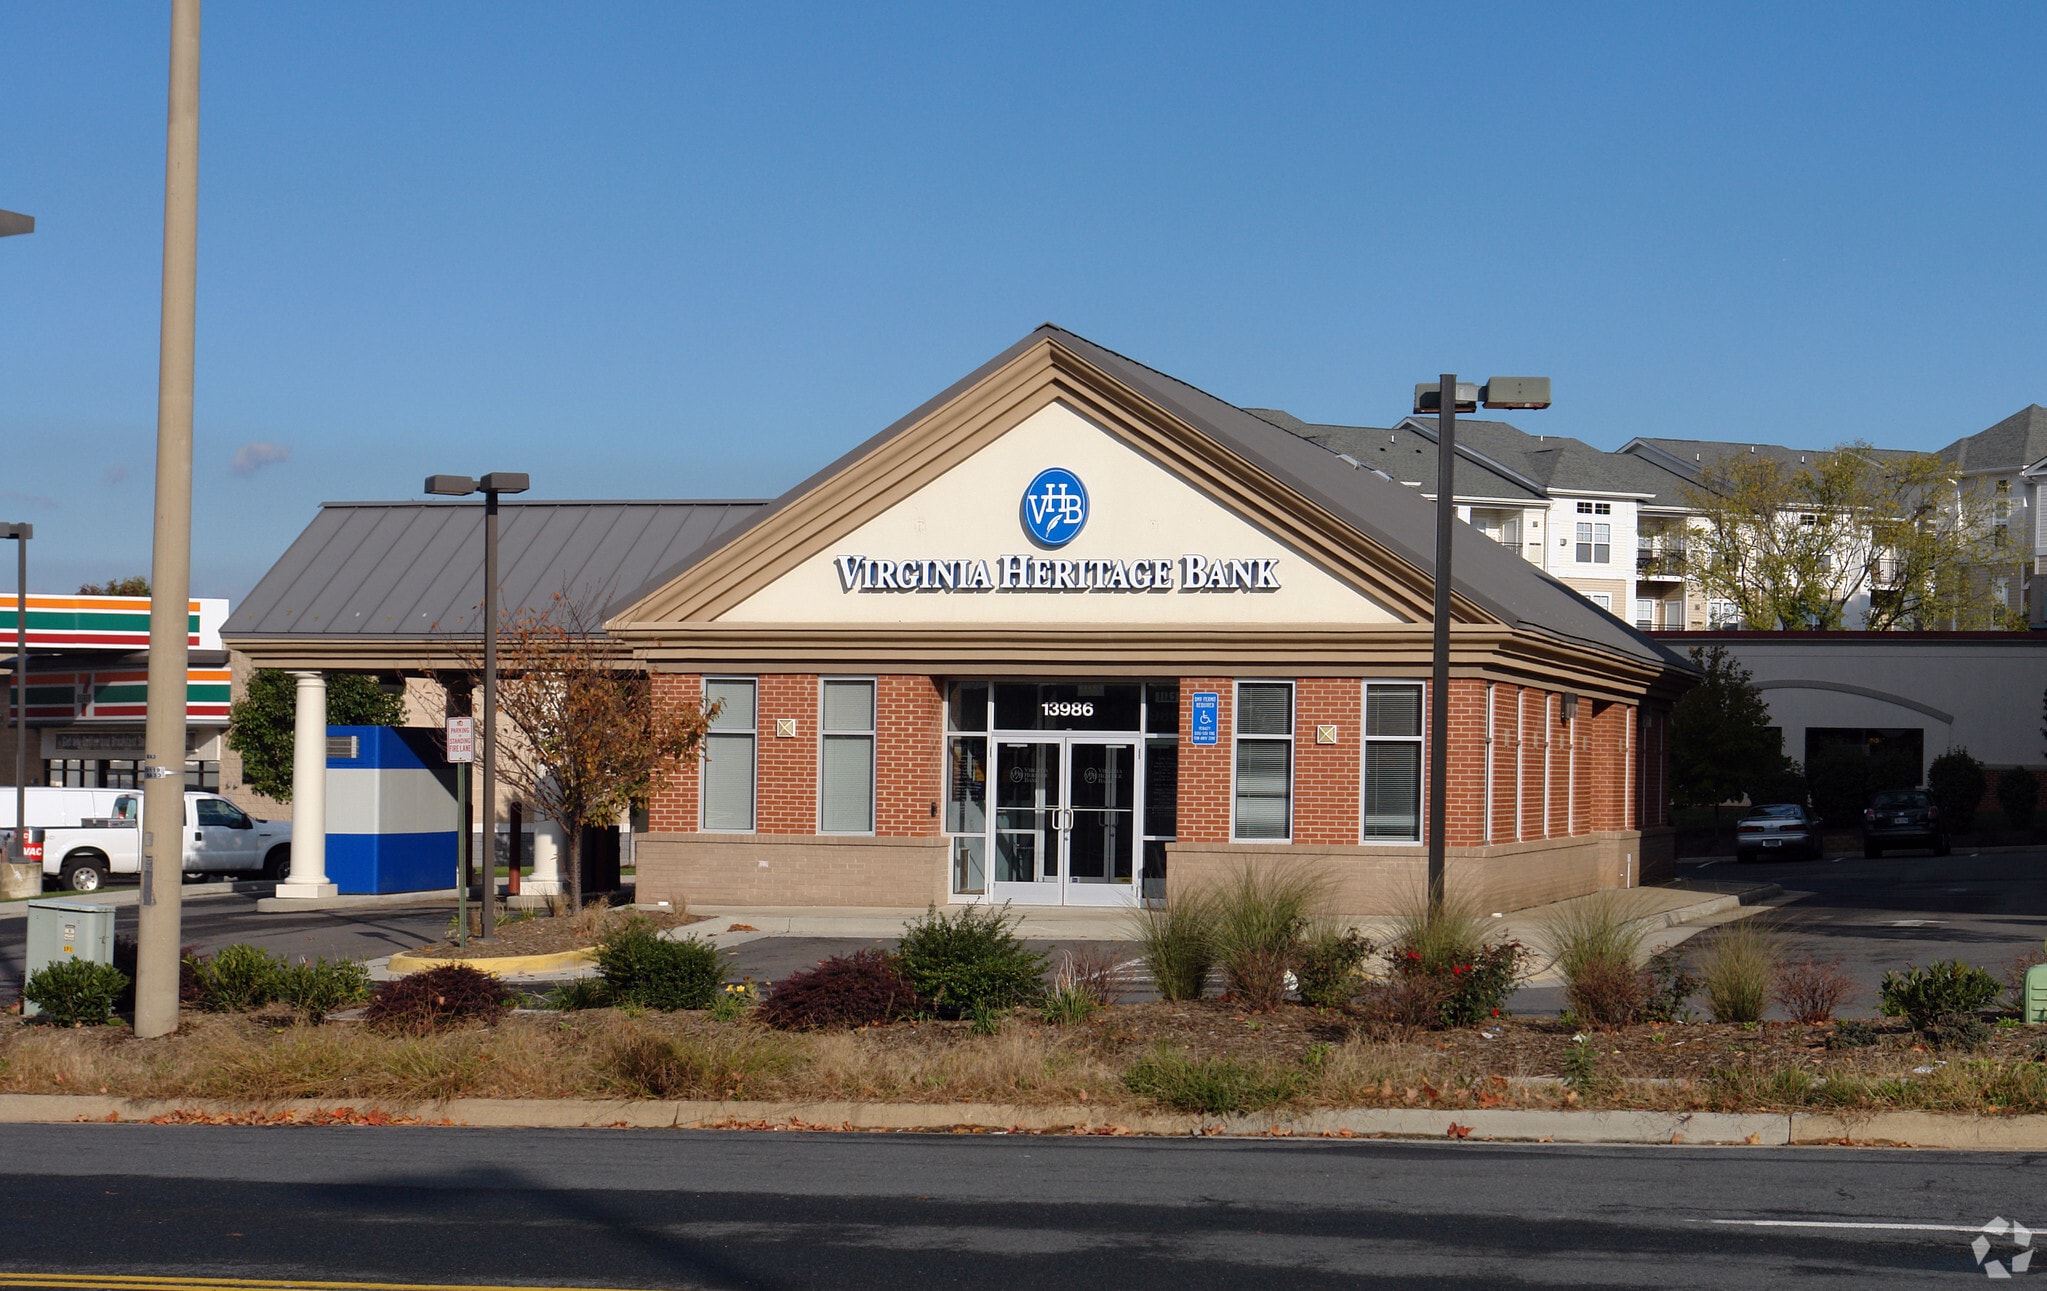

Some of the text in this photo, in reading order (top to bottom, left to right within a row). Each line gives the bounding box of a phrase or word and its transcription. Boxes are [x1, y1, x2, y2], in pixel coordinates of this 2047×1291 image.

[836, 553, 1281, 590] VIRGINIA HERITAGE BANK
[1041, 701, 1094, 717] 13986
[23, 847, 43, 856] VAC
